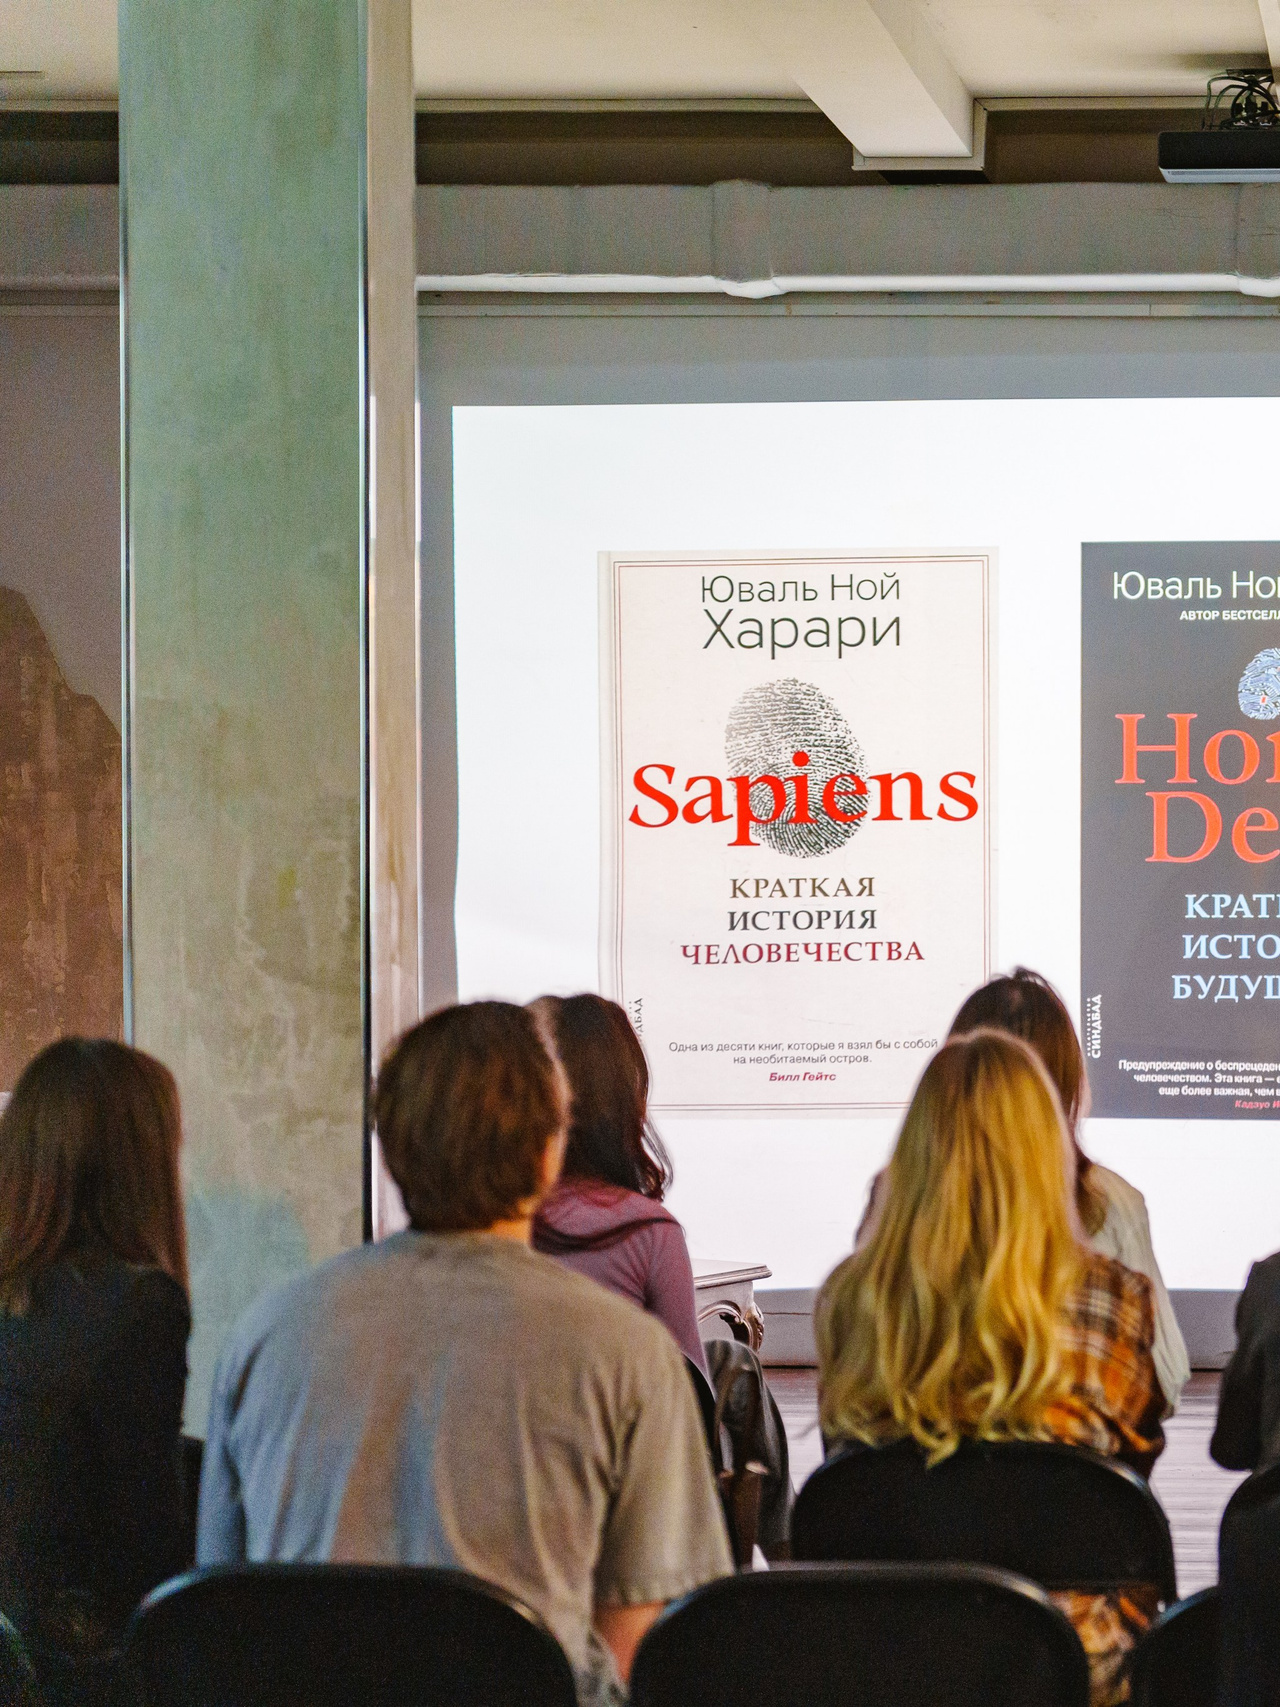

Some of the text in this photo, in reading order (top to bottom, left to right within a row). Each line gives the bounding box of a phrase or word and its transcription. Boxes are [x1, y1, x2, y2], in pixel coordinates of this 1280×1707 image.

[702, 572, 900, 603] Юваль Ной
[1113, 571, 1222, 600] Юваль
[1179, 610, 1220, 621] АВТОР
[702, 608, 901, 660] Харари
[628, 750, 980, 847] Sapiens
[730, 876, 875, 899] КРАТКАЯ
[727, 909, 877, 931] ИСТОРИЯ
[680, 941, 925, 965] ЧЕЛОВЕЧЕСТВА
[1091, 994, 1102, 1059] СИНДБАД
[668, 1038, 938, 1052] Одна из десяти книг, которые я взял бы с собой
[733, 1053, 873, 1064] на необитаемый остров.
[1118, 1059, 1205, 1072] Предупреждение
[1206, 1062, 1213, 1071] о
[769, 1072, 837, 1081] Билл Гейтс
[1133, 1073, 1212, 1083] человечеством.
[1214, 1073, 1233, 1083] Эта
[1234, 1075, 1263, 1083] книга
[1159, 1086, 1180, 1096] еще
[1181, 1085, 1212, 1096] более
[1214, 1087, 1253, 1097] важная,
[1254, 1087, 1275, 1097] чем
[1234, 1100, 1271, 1109] Кадзуо
